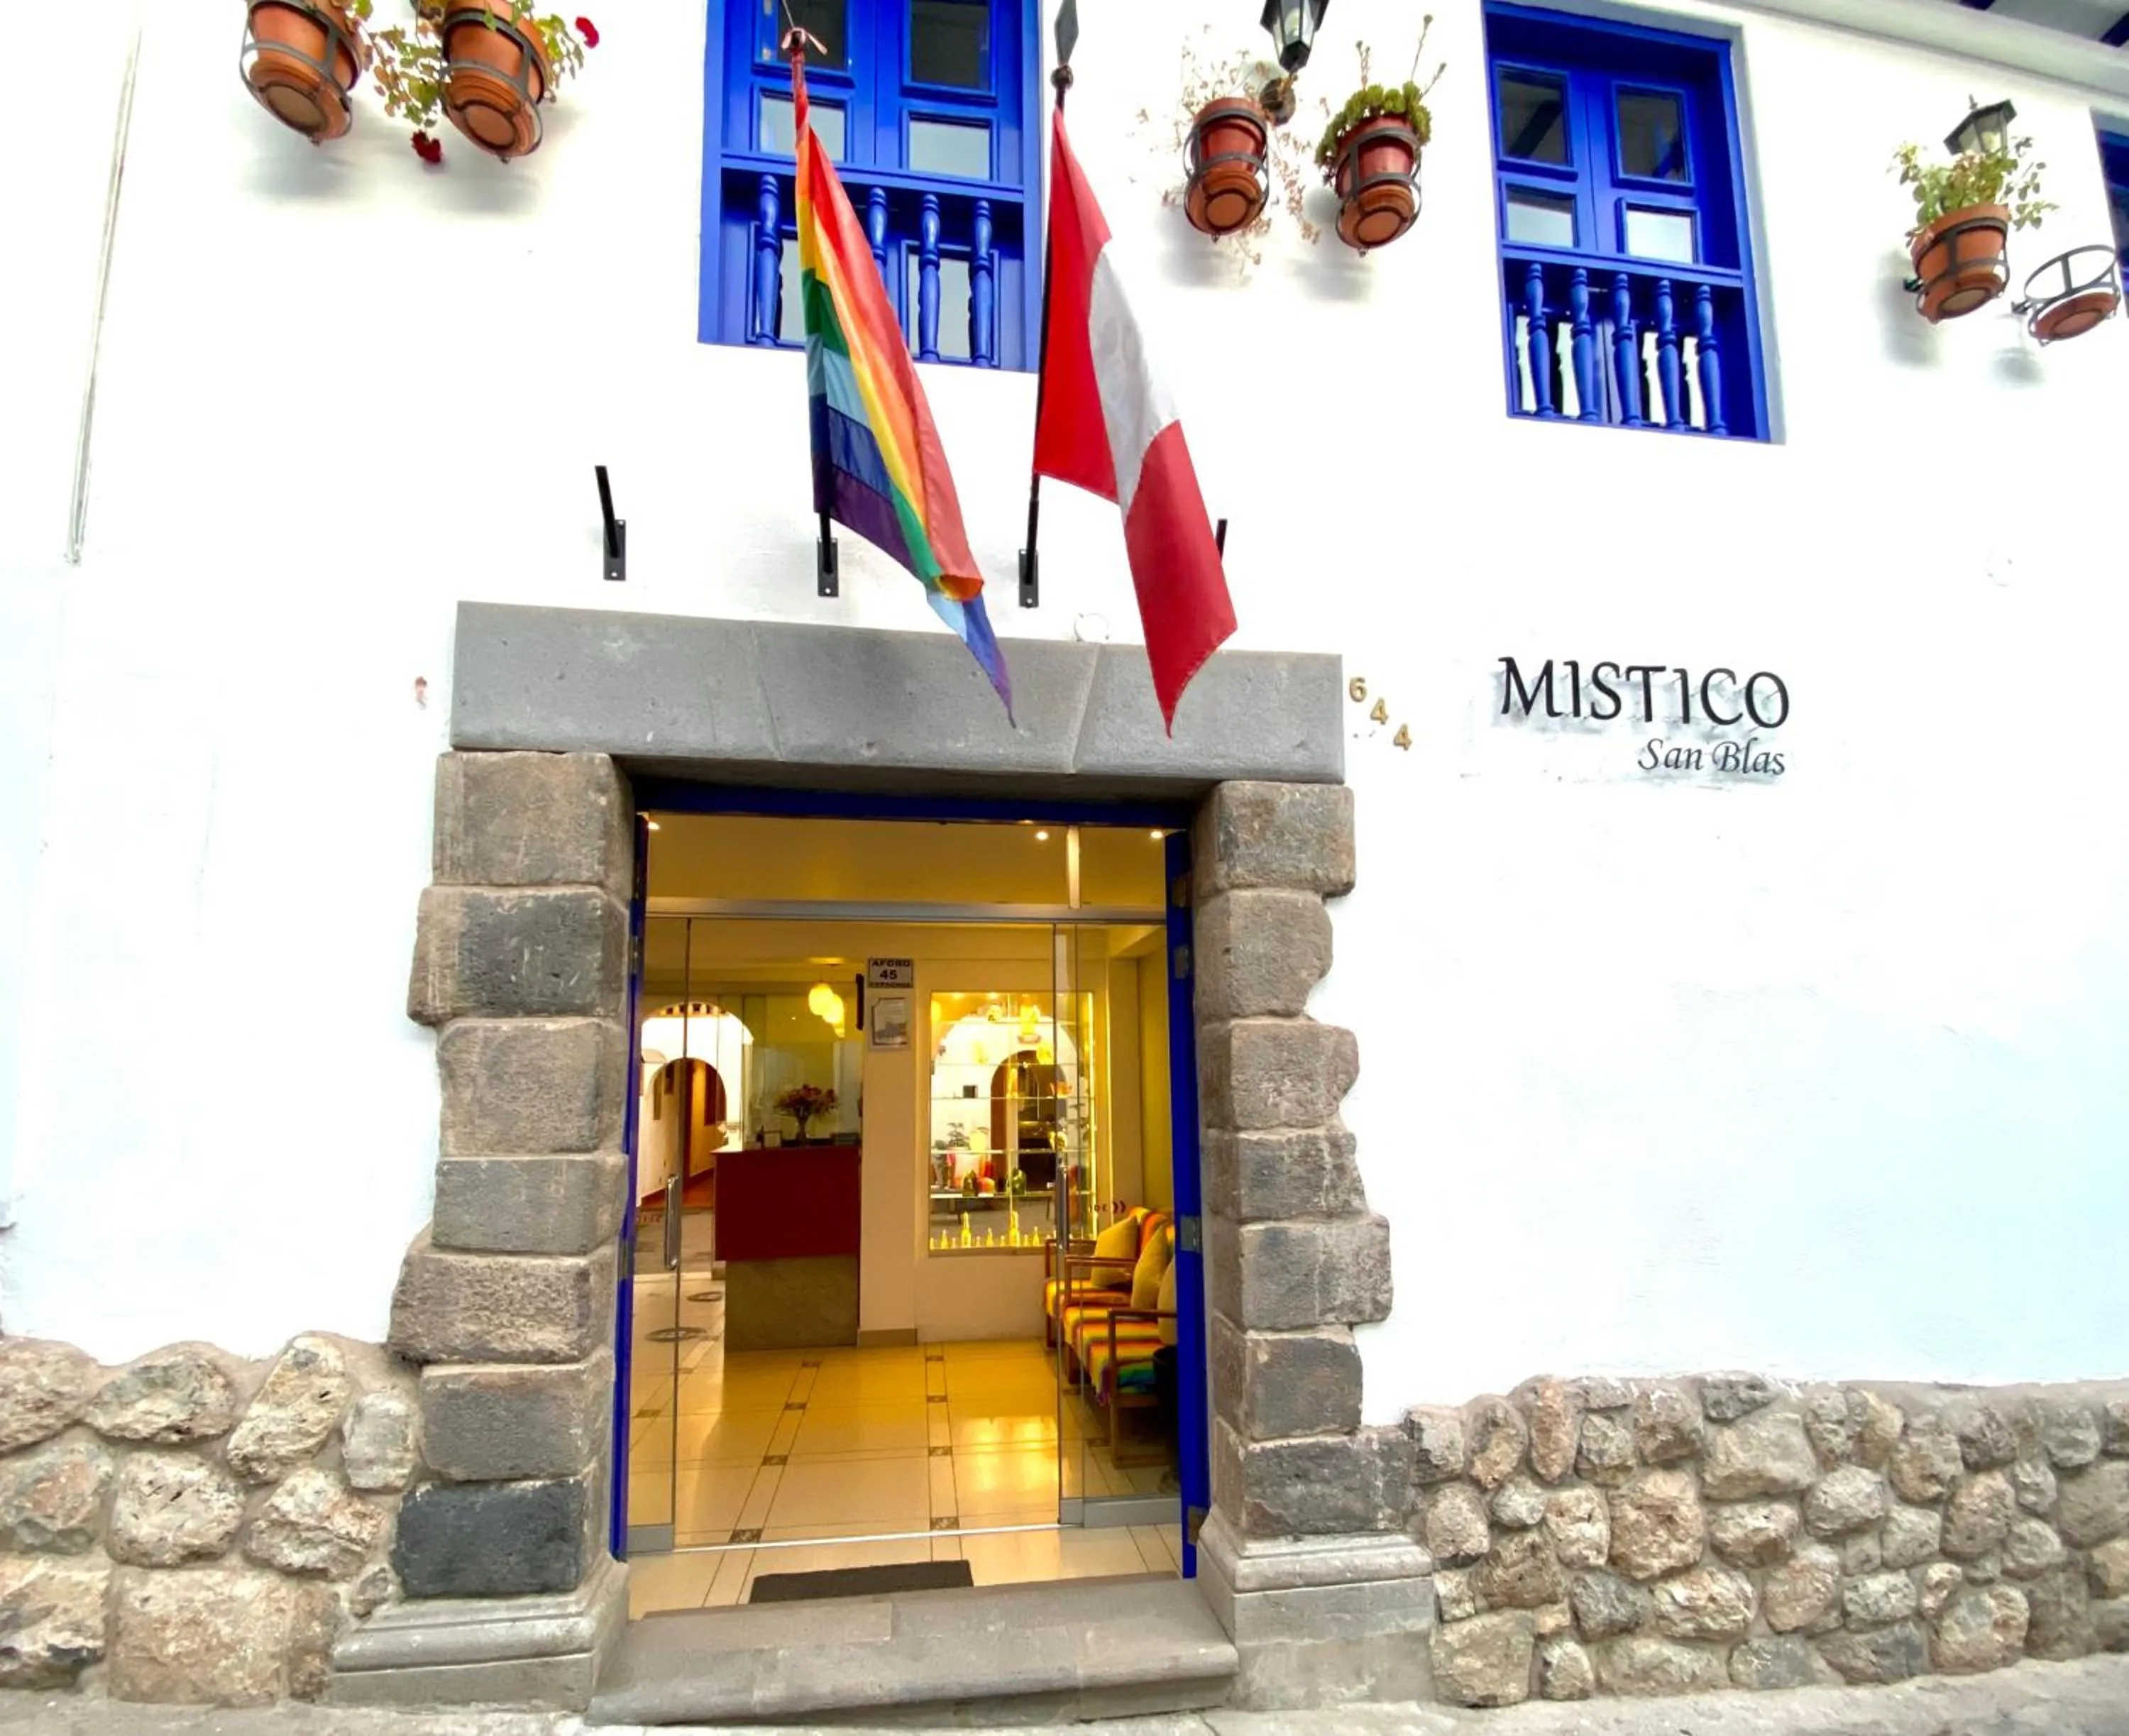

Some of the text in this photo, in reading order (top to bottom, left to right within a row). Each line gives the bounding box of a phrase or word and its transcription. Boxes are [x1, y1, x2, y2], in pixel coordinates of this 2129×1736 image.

[1348, 676, 1412, 752] 644
[1637, 738, 1786, 776] San Blas
[879, 969, 898, 980] 45
